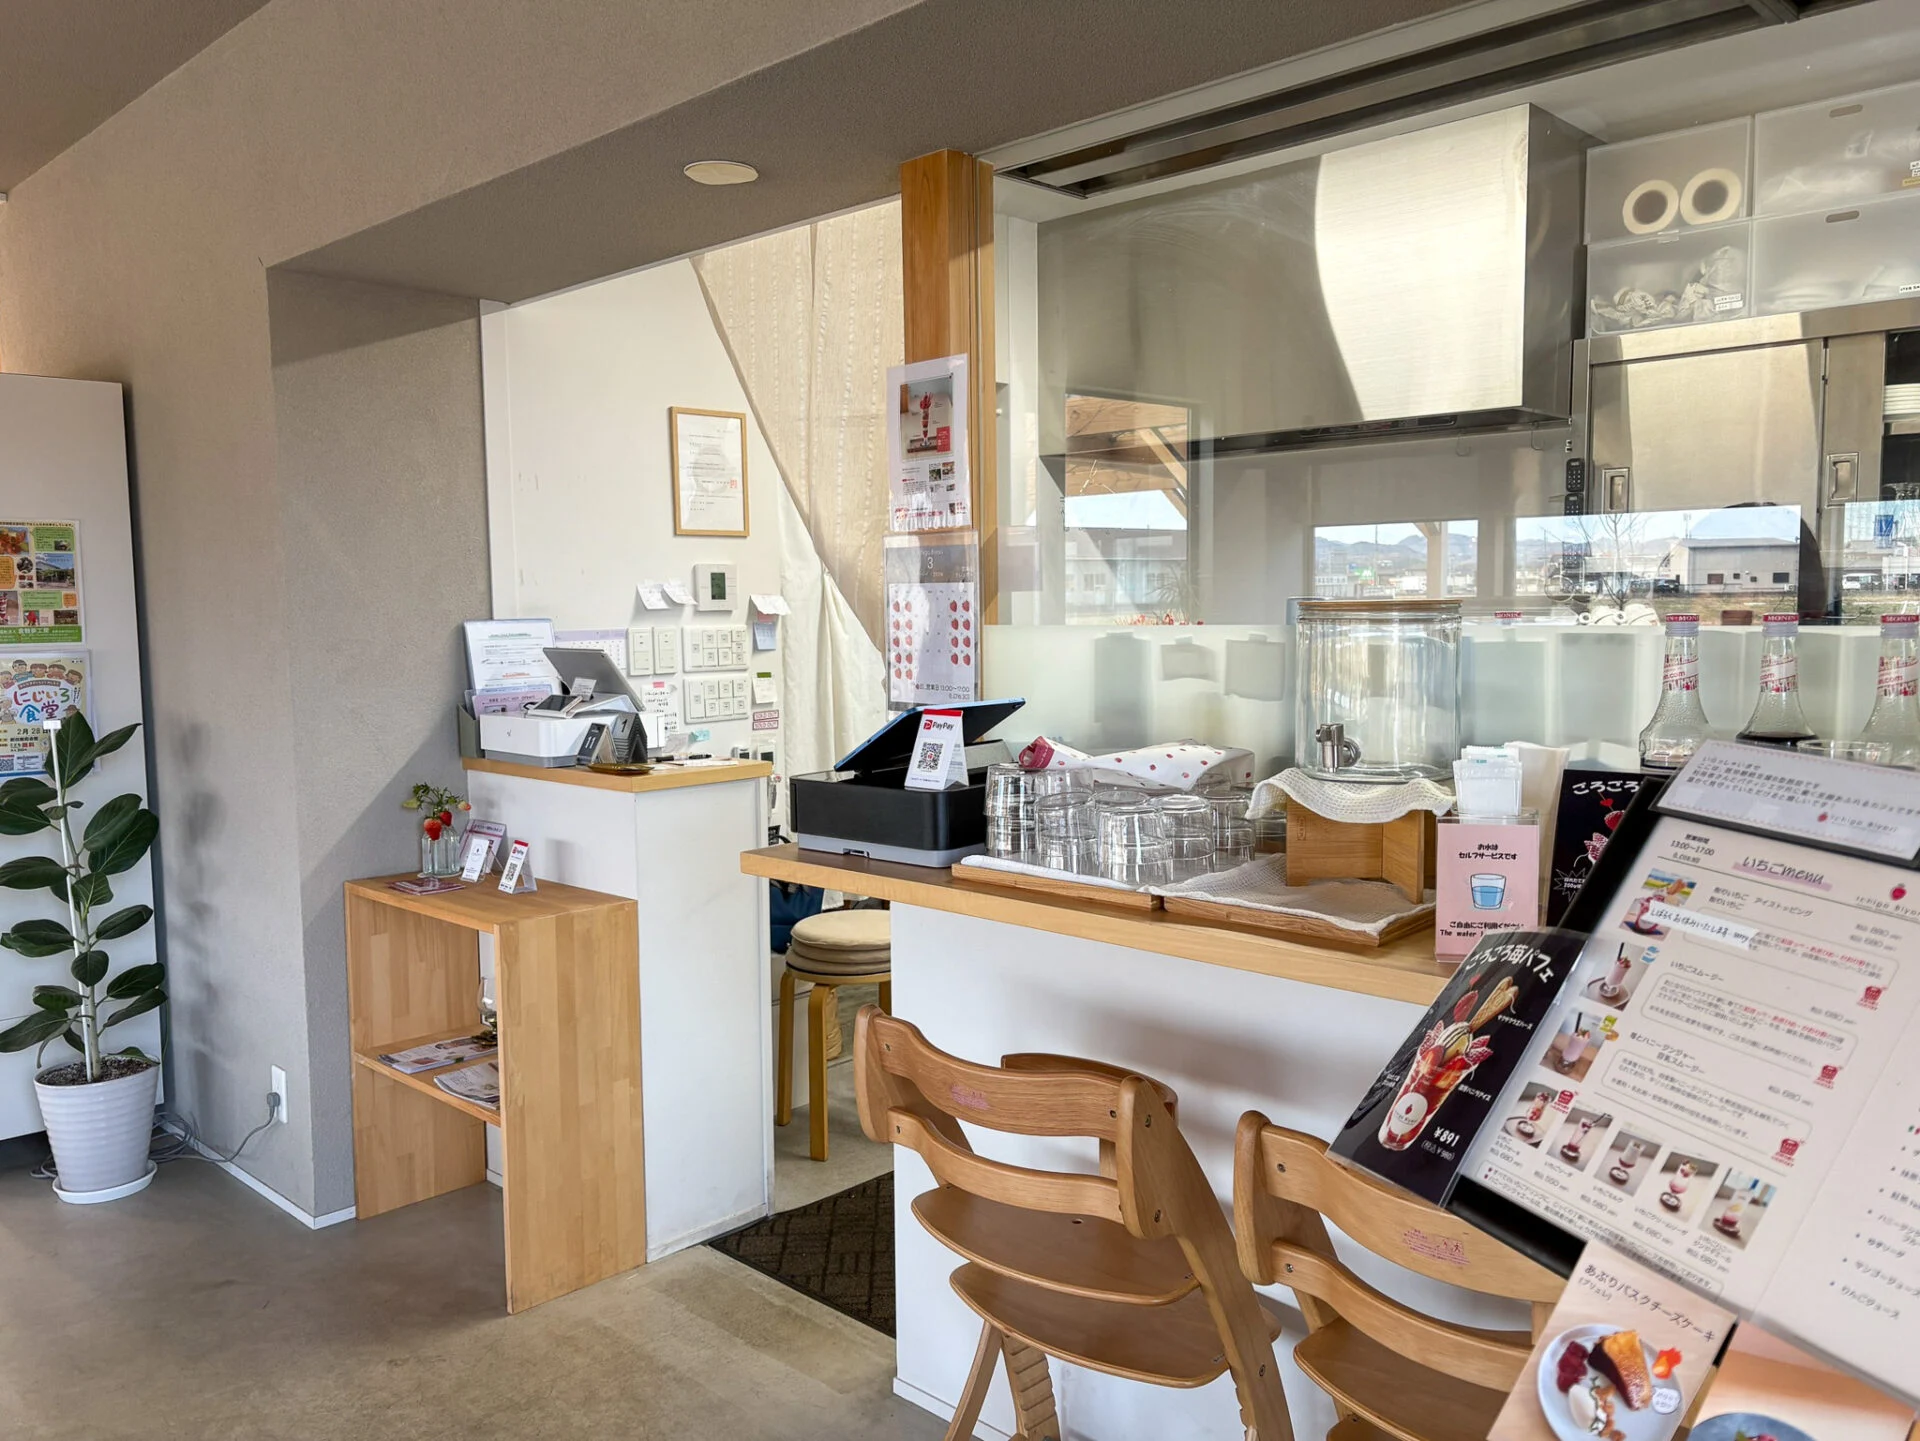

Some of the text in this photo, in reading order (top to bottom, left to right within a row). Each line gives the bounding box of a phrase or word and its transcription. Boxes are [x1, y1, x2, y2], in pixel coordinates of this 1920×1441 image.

[927, 556, 934, 569] 3
[13, 687, 70, 706] にじいろ
[19, 700, 60, 723] 食堂
[620, 718, 628, 733] 1
[932, 721, 955, 731] PayPay
[585, 736, 596, 749] 11
[1572, 780, 1645, 796] ごろごろ
[1477, 843, 1499, 851] お水は
[1458, 852, 1518, 861] セルフサービスです
[1439, 929, 1477, 938] The water
[1465, 944, 1555, 984] ごろごろ苺パフェ
[1433, 1126, 1461, 1148] ¥891
[1584, 1264, 1716, 1344] あぶりバスクチーズケーキ
